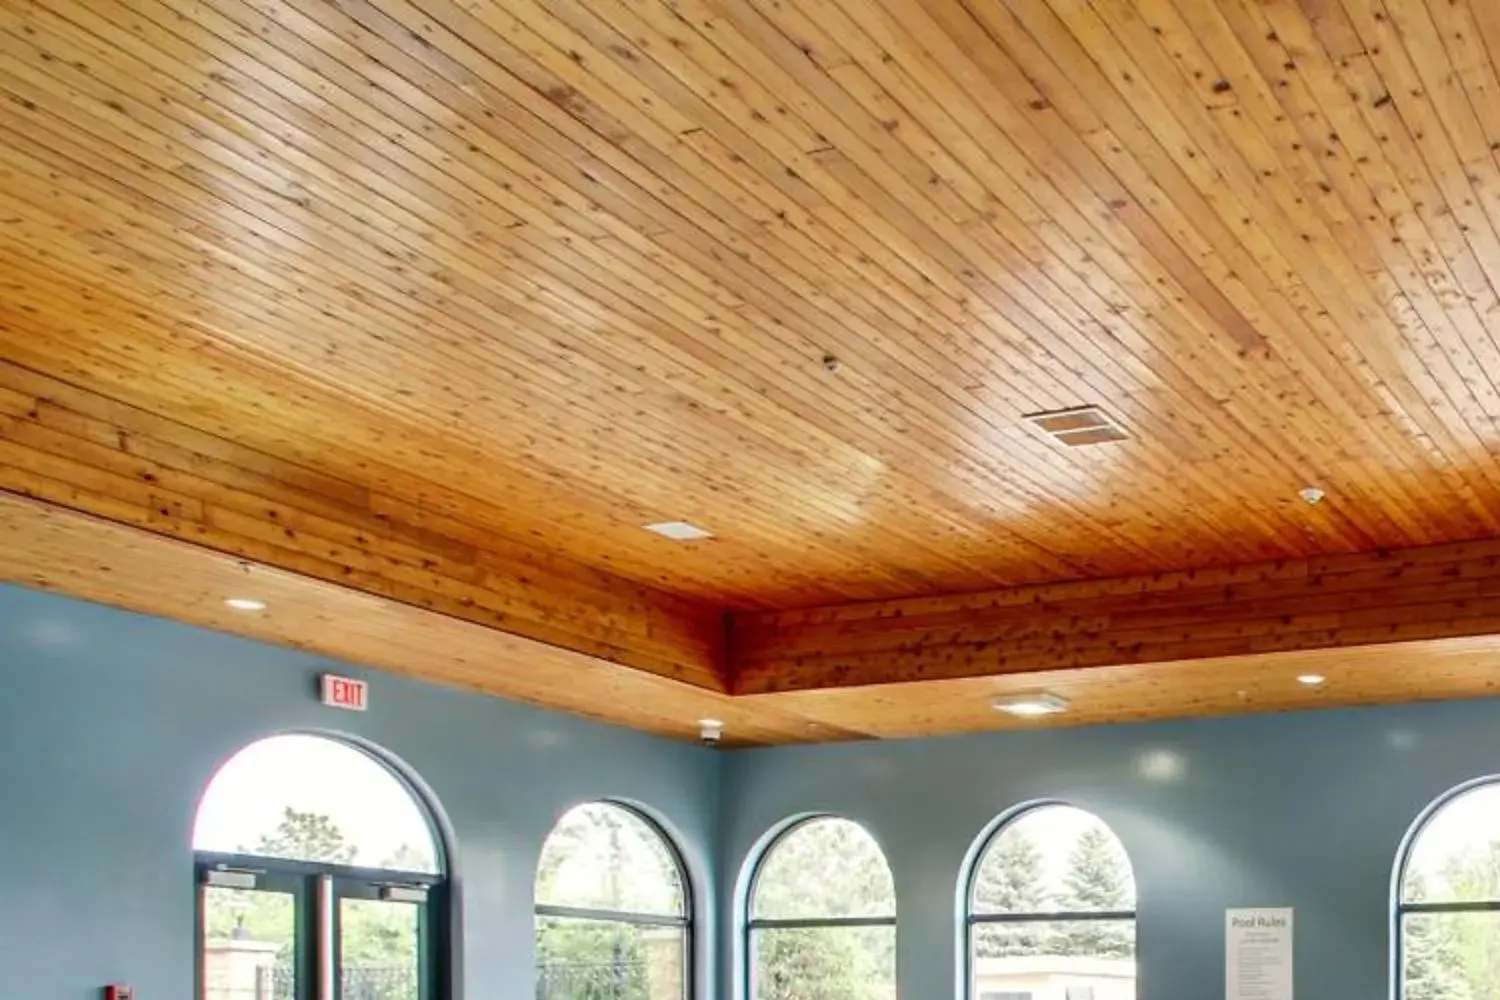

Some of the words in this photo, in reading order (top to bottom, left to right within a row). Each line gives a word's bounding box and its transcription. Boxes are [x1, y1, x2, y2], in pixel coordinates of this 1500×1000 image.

[332, 679, 363, 706] EXIT
[1231, 915, 1255, 928] Pool
[1257, 915, 1287, 928] Rules
